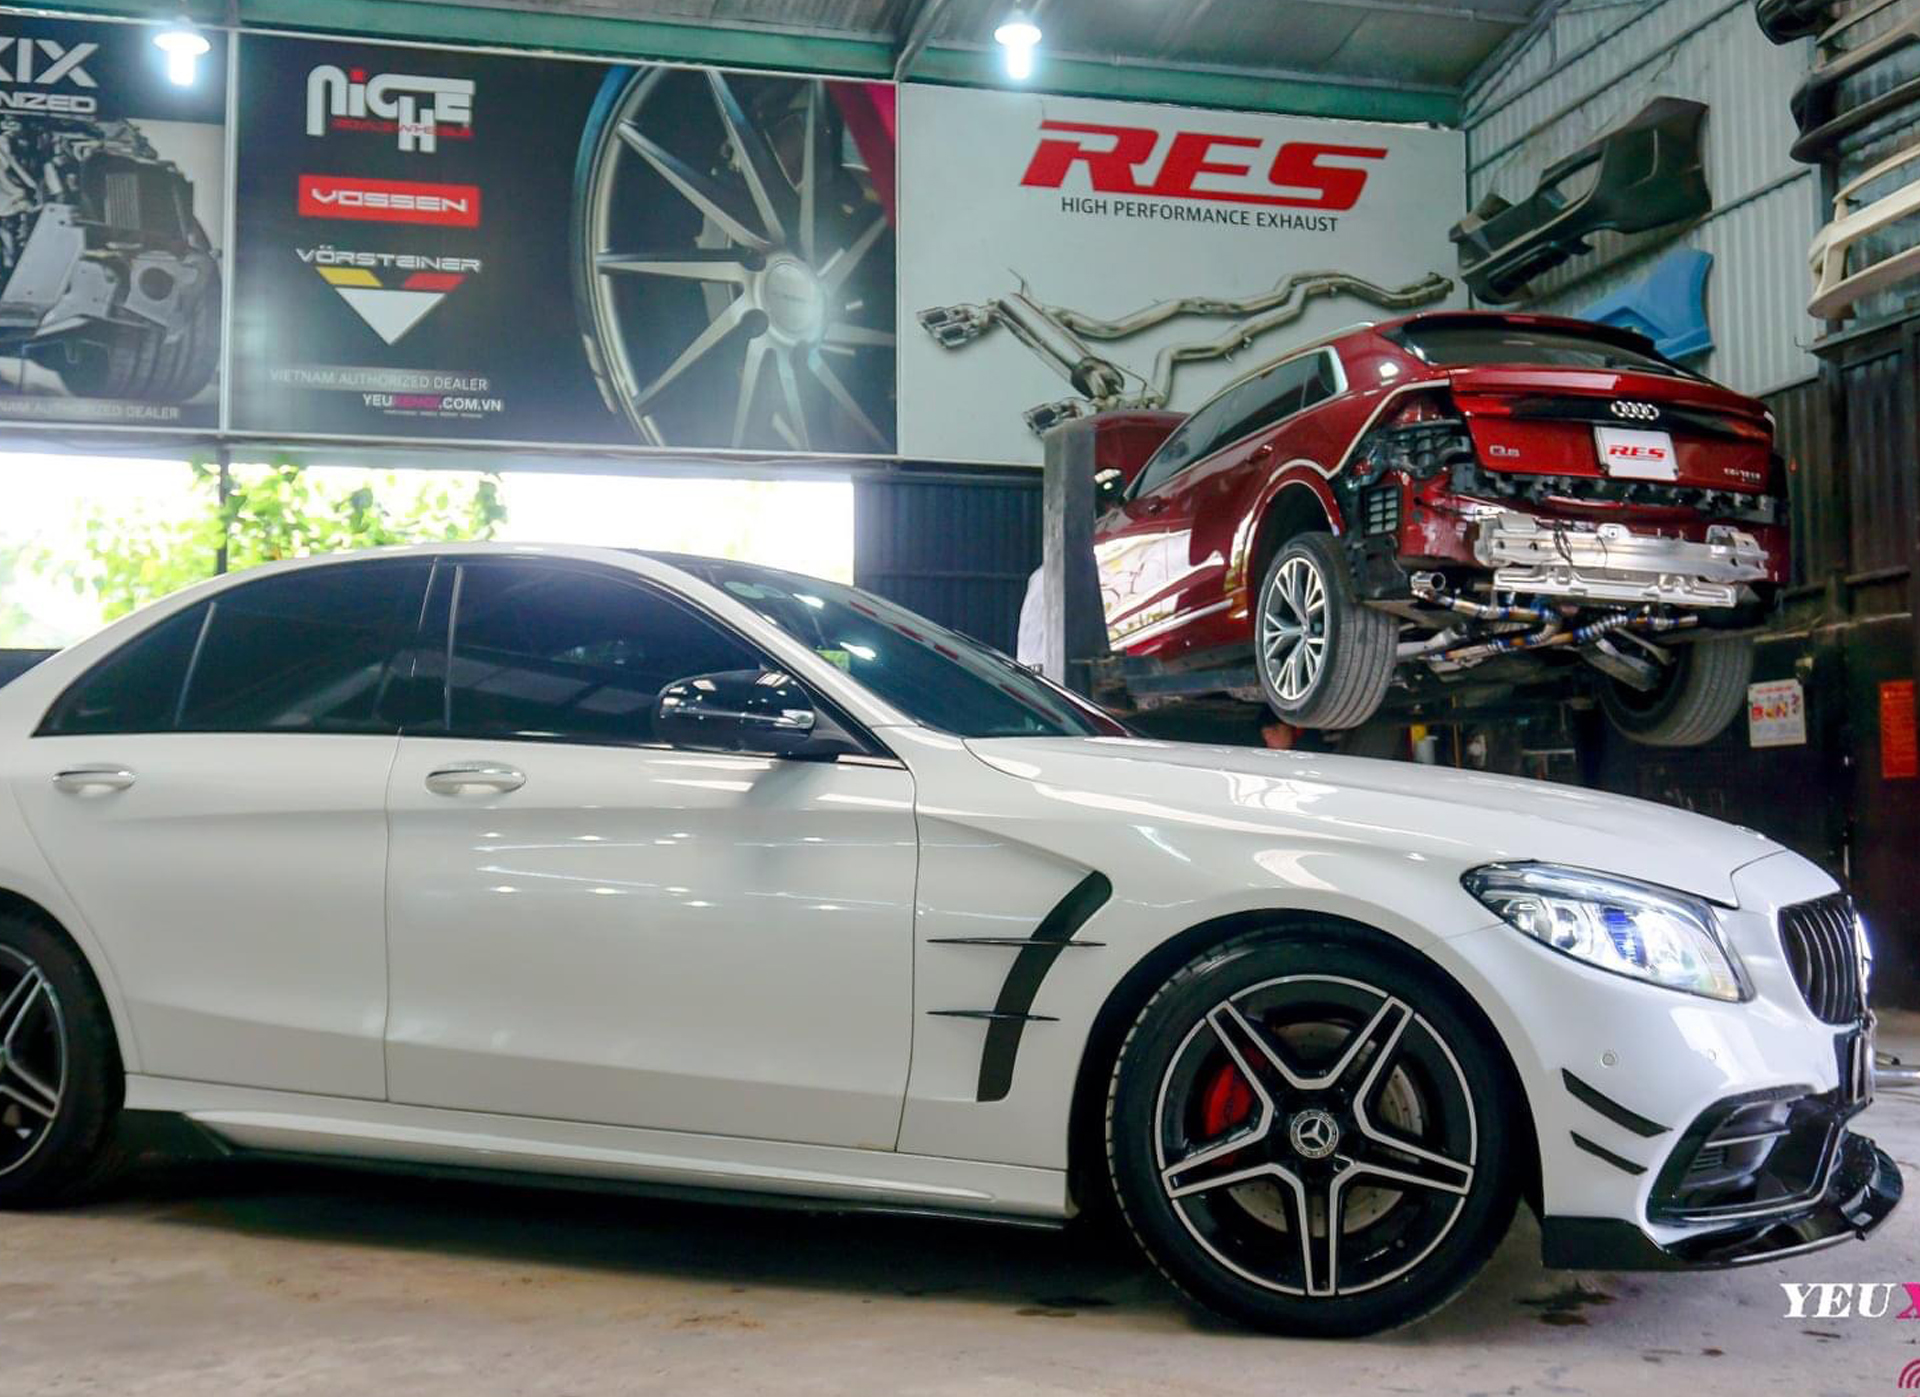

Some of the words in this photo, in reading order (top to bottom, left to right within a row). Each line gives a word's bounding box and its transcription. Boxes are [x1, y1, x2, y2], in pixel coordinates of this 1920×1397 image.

[1020, 119, 1389, 211] RES
[311, 188, 468, 212] VOSSEN
[1061, 197, 1108, 215] HIGH
[1113, 202, 1250, 226] PERFORMANCE
[1256, 211, 1339, 233] EXHAUST
[296, 244, 482, 273] VÖRSTEINER
[269, 368, 335, 385] VIETNAM
[338, 371, 430, 389] AUTHORIZED
[433, 376, 488, 391] DEALER
[126, 405, 180, 419] DEALER
[1608, 444, 1666, 459] RES
